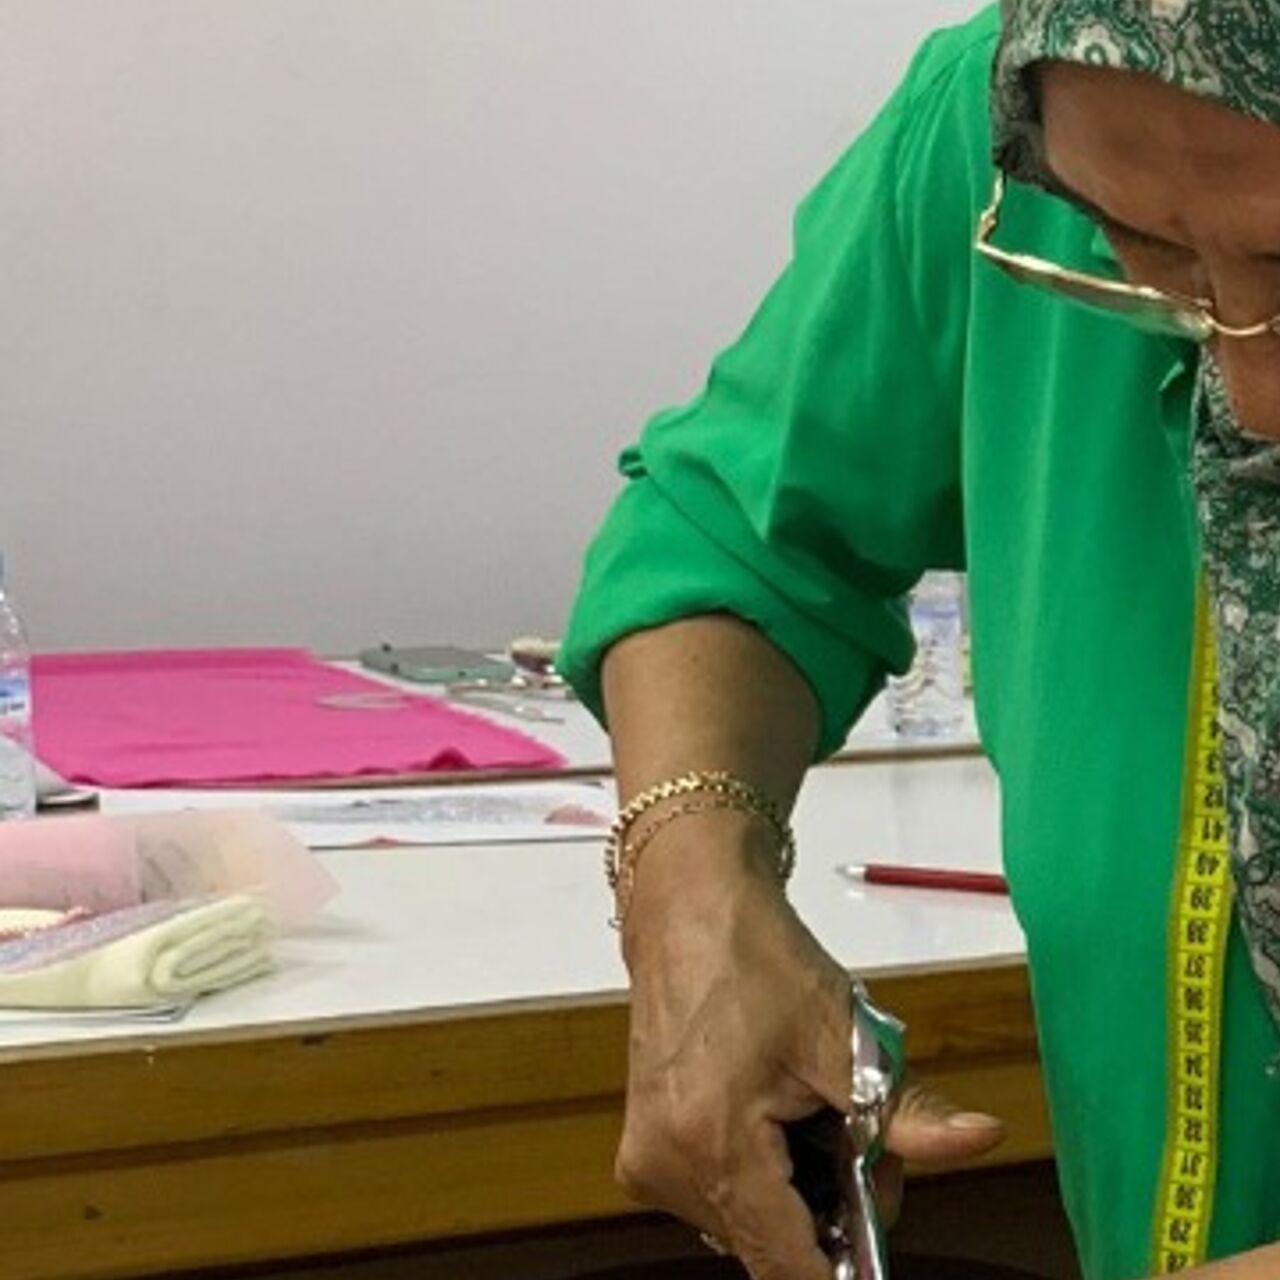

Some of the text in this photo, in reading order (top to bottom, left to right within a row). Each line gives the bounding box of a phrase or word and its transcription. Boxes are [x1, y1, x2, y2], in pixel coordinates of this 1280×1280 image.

[1191, 886, 1214, 910] 39
[1187, 920, 1210, 943] 38
[1185, 954, 1206, 977] 37
